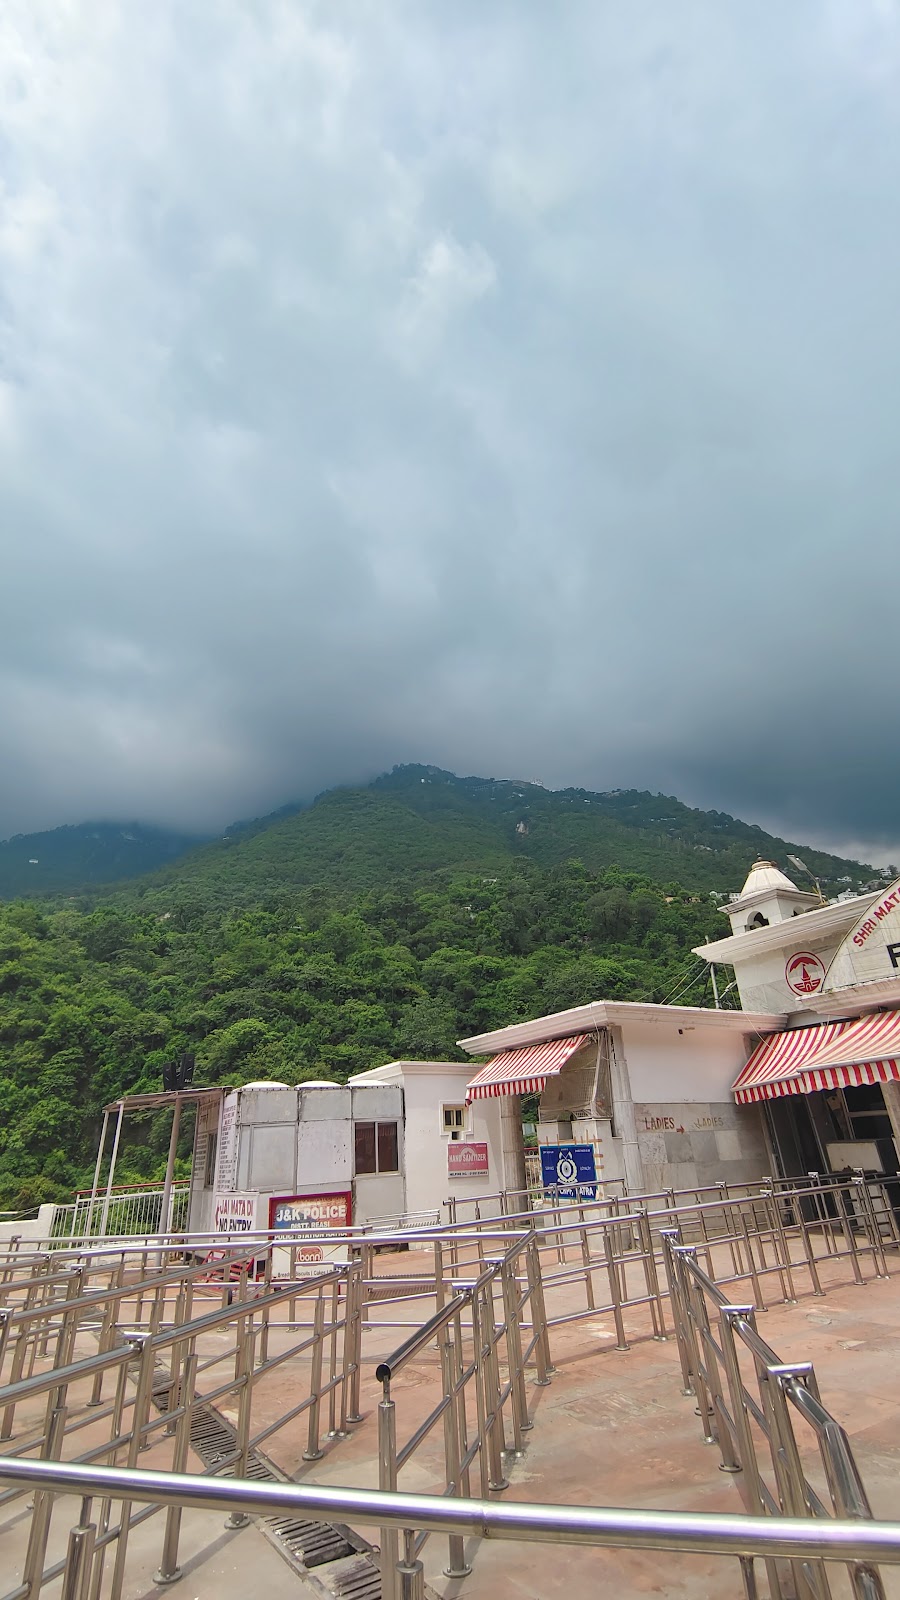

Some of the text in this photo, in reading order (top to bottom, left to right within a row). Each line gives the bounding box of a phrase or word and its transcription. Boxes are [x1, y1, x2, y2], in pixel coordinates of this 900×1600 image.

[853, 887, 900, 947] SHRI MAT
[644, 1116, 675, 1130] LADIES
[697, 1117, 724, 1127] LADIES
[219, 1199, 254, 1217] JAI MATA DI
[276, 1204, 347, 1222] J&K POLICE
[218, 1217, 252, 1232] NO ENTRY
[300, 1249, 320, 1261] bonn
